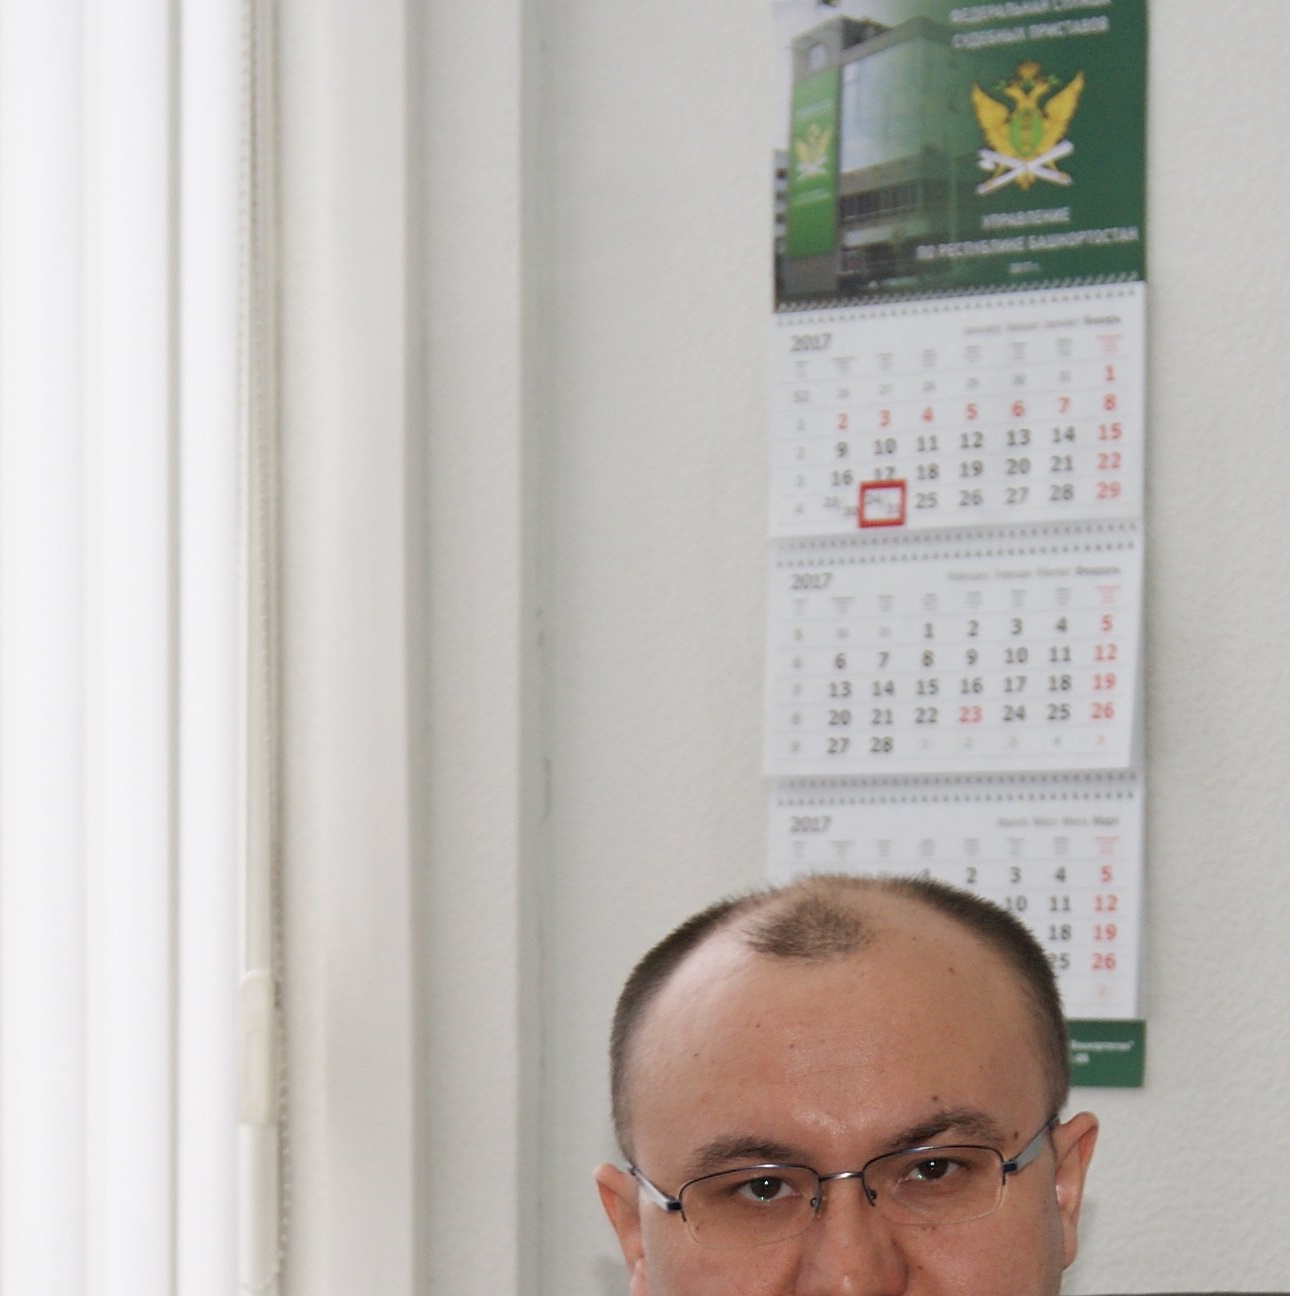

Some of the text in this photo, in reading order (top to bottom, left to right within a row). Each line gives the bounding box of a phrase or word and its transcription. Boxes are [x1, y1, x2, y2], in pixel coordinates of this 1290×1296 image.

[790, 333, 832, 353] 2017
[1105, 365, 1115, 383] 1
[837, 413, 848, 431] 2
[879, 410, 891, 428] 3
[921, 407, 933, 423] 4
[966, 403, 978, 421] 5
[1012, 401, 1025, 417] 6
[1058, 397, 1070, 414] 7
[1104, 394, 1116, 411] 8
[836, 442, 848, 458] 9
[874, 438, 897, 456] 10
[917, 435, 938, 453] 11
[960, 432, 983, 449] 12
[1007, 429, 1030, 448] 13
[1053, 426, 1076, 443] 14
[1099, 423, 1122, 441] 15
[832, 469, 854, 487] 16
[873, 465, 896, 481] 17
[917, 463, 939, 481] 18
[960, 460, 983, 478] 19
[1006, 458, 1031, 477] 20
[1051, 455, 1073, 473] 21
[1097, 452, 1121, 471] 22
[915, 492, 938, 510] 25
[959, 489, 983, 507] 26
[1005, 487, 1029, 506] 27
[1050, 484, 1074, 501] 28
[1096, 482, 1121, 500] 29
[791, 572, 832, 591] 2017
[924, 622, 934, 640] 1
[968, 620, 979, 637] 2
[1011, 618, 1023, 636] 3
[1056, 618, 1067, 632] 4
[1101, 615, 1113, 632] 5
[834, 653, 846, 669] 6
[879, 651, 890, 668] 7
[922, 651, 933, 667] 8
[967, 649, 978, 666] 9
[1005, 647, 1028, 664] 10
[1049, 646, 1071, 664] 11
[1094, 644, 1117, 662] 12
[829, 681, 852, 699] 13
[873, 680, 895, 697] 14
[917, 679, 939, 696] 15
[961, 677, 983, 695] 16
[1004, 676, 1027, 694] 17
[1049, 674, 1071, 692] 18
[1093, 673, 1116, 691] 19
[828, 709, 851, 726] 20
[871, 708, 893, 726] 21
[915, 707, 938, 724] 22
[958, 706, 982, 724] 23
[1003, 705, 1026, 722] 24
[1047, 704, 1070, 721] 25
[1091, 702, 1114, 720] 26
[827, 737, 850, 755] 27
[871, 737, 893, 753] 28
[790, 816, 832, 834] 2017
[966, 866, 1112, 884] 2 3 4 5
[1005, 895, 1117, 913] 10 11 12
[1049, 924, 1117, 941] 18 19
[1092, 953, 1116, 971] 26
